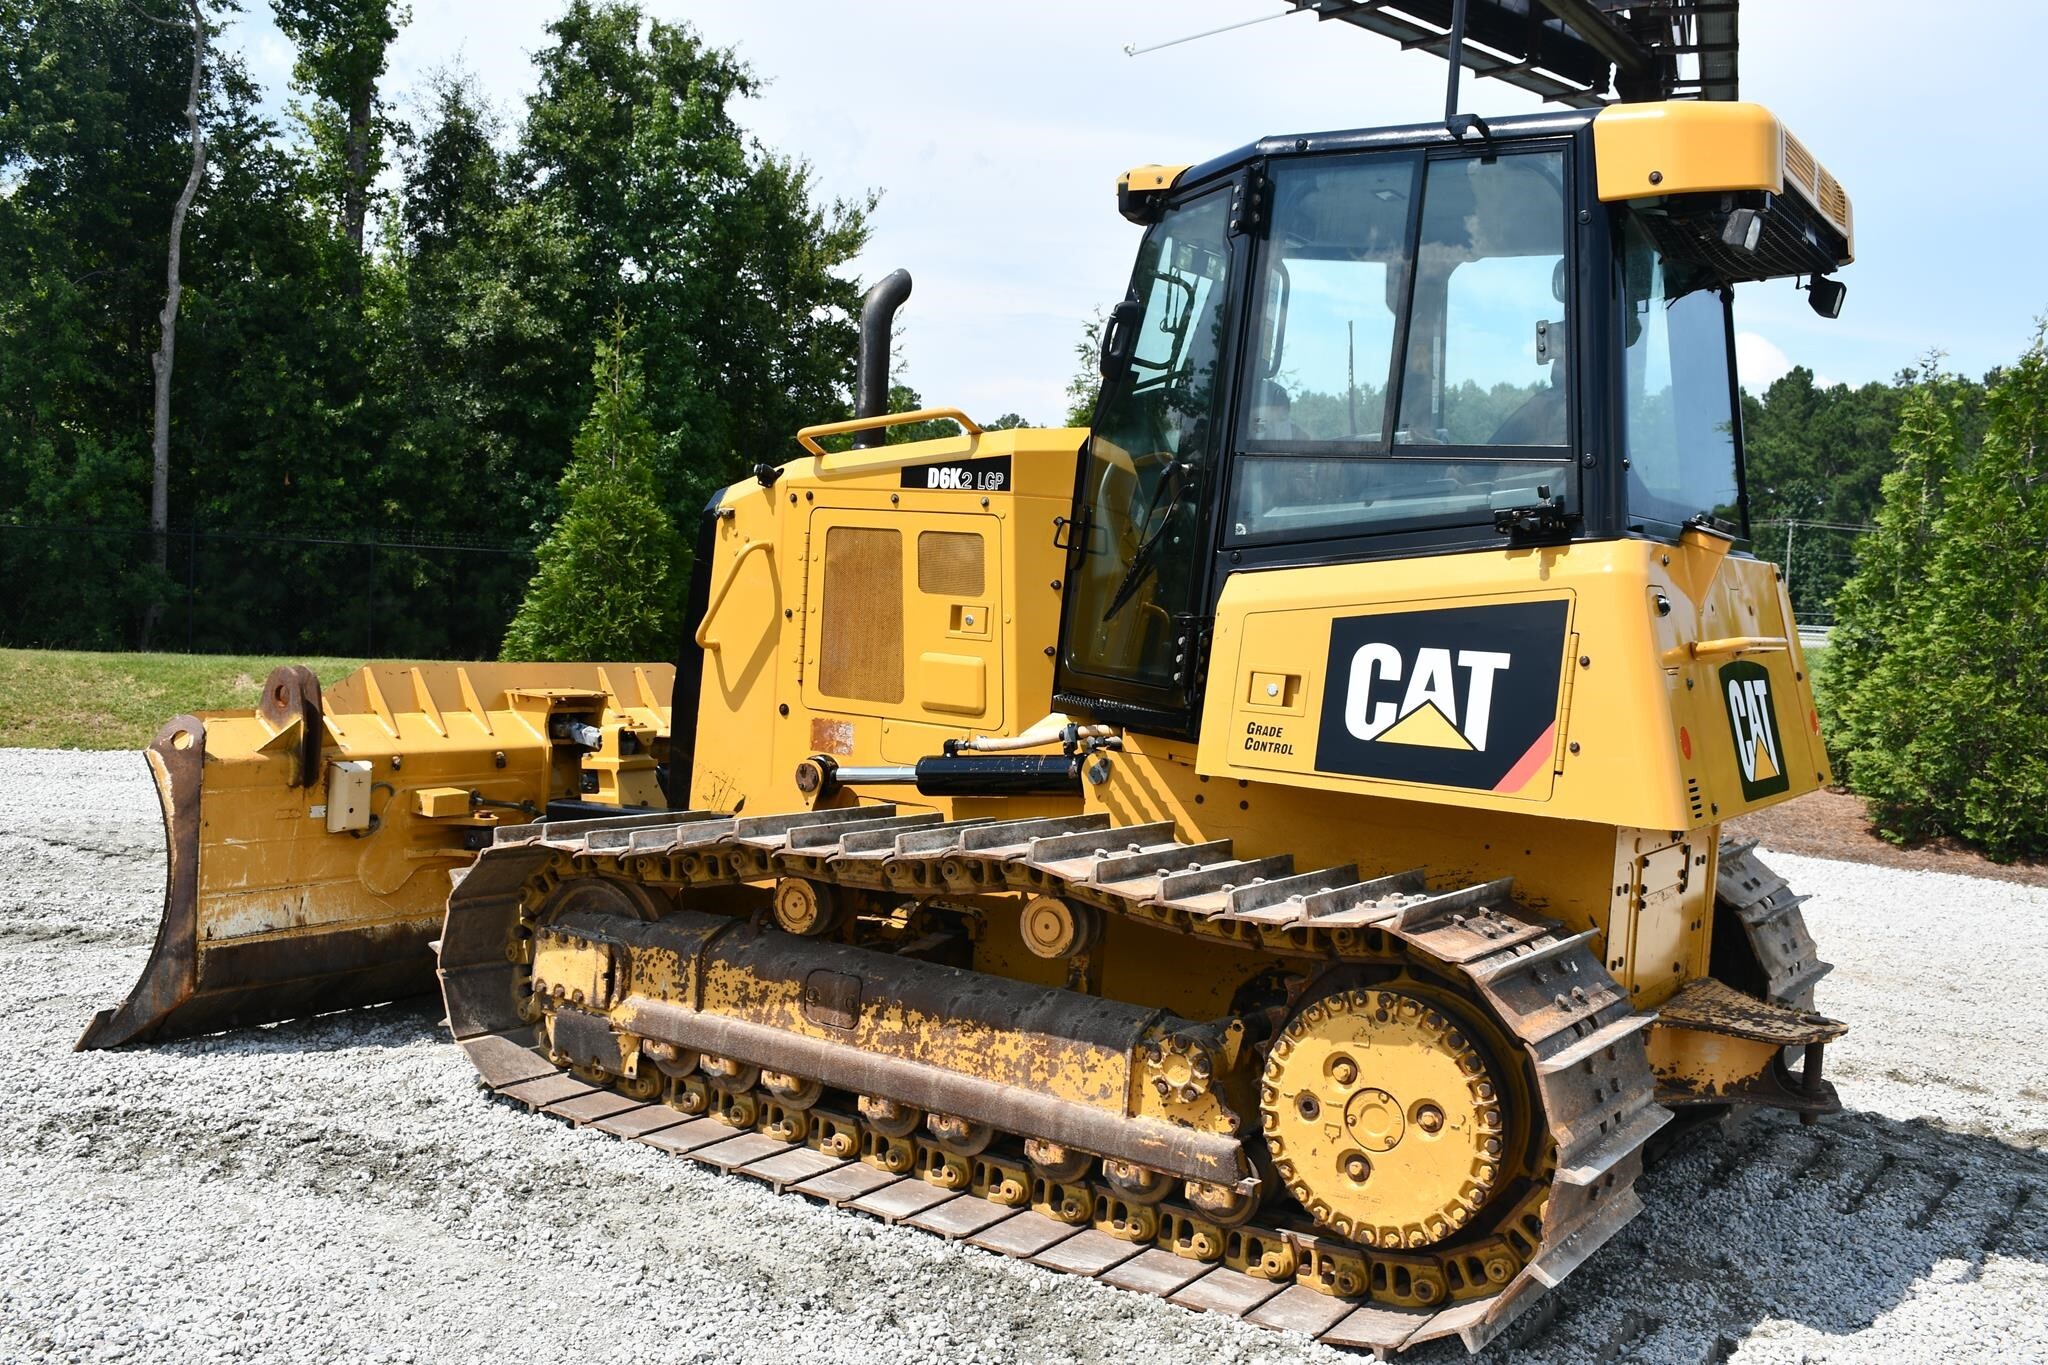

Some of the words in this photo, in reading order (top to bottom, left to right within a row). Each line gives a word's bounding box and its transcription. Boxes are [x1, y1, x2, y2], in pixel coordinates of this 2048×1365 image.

[927, 467, 973, 489] D6K2
[977, 471, 1005, 490] LGP
[1344, 642, 1511, 752] CAT
[1246, 721, 1284, 738] GRADE
[1728, 679, 1780, 783] CAT
[1244, 737, 1294, 756] CONTROL
